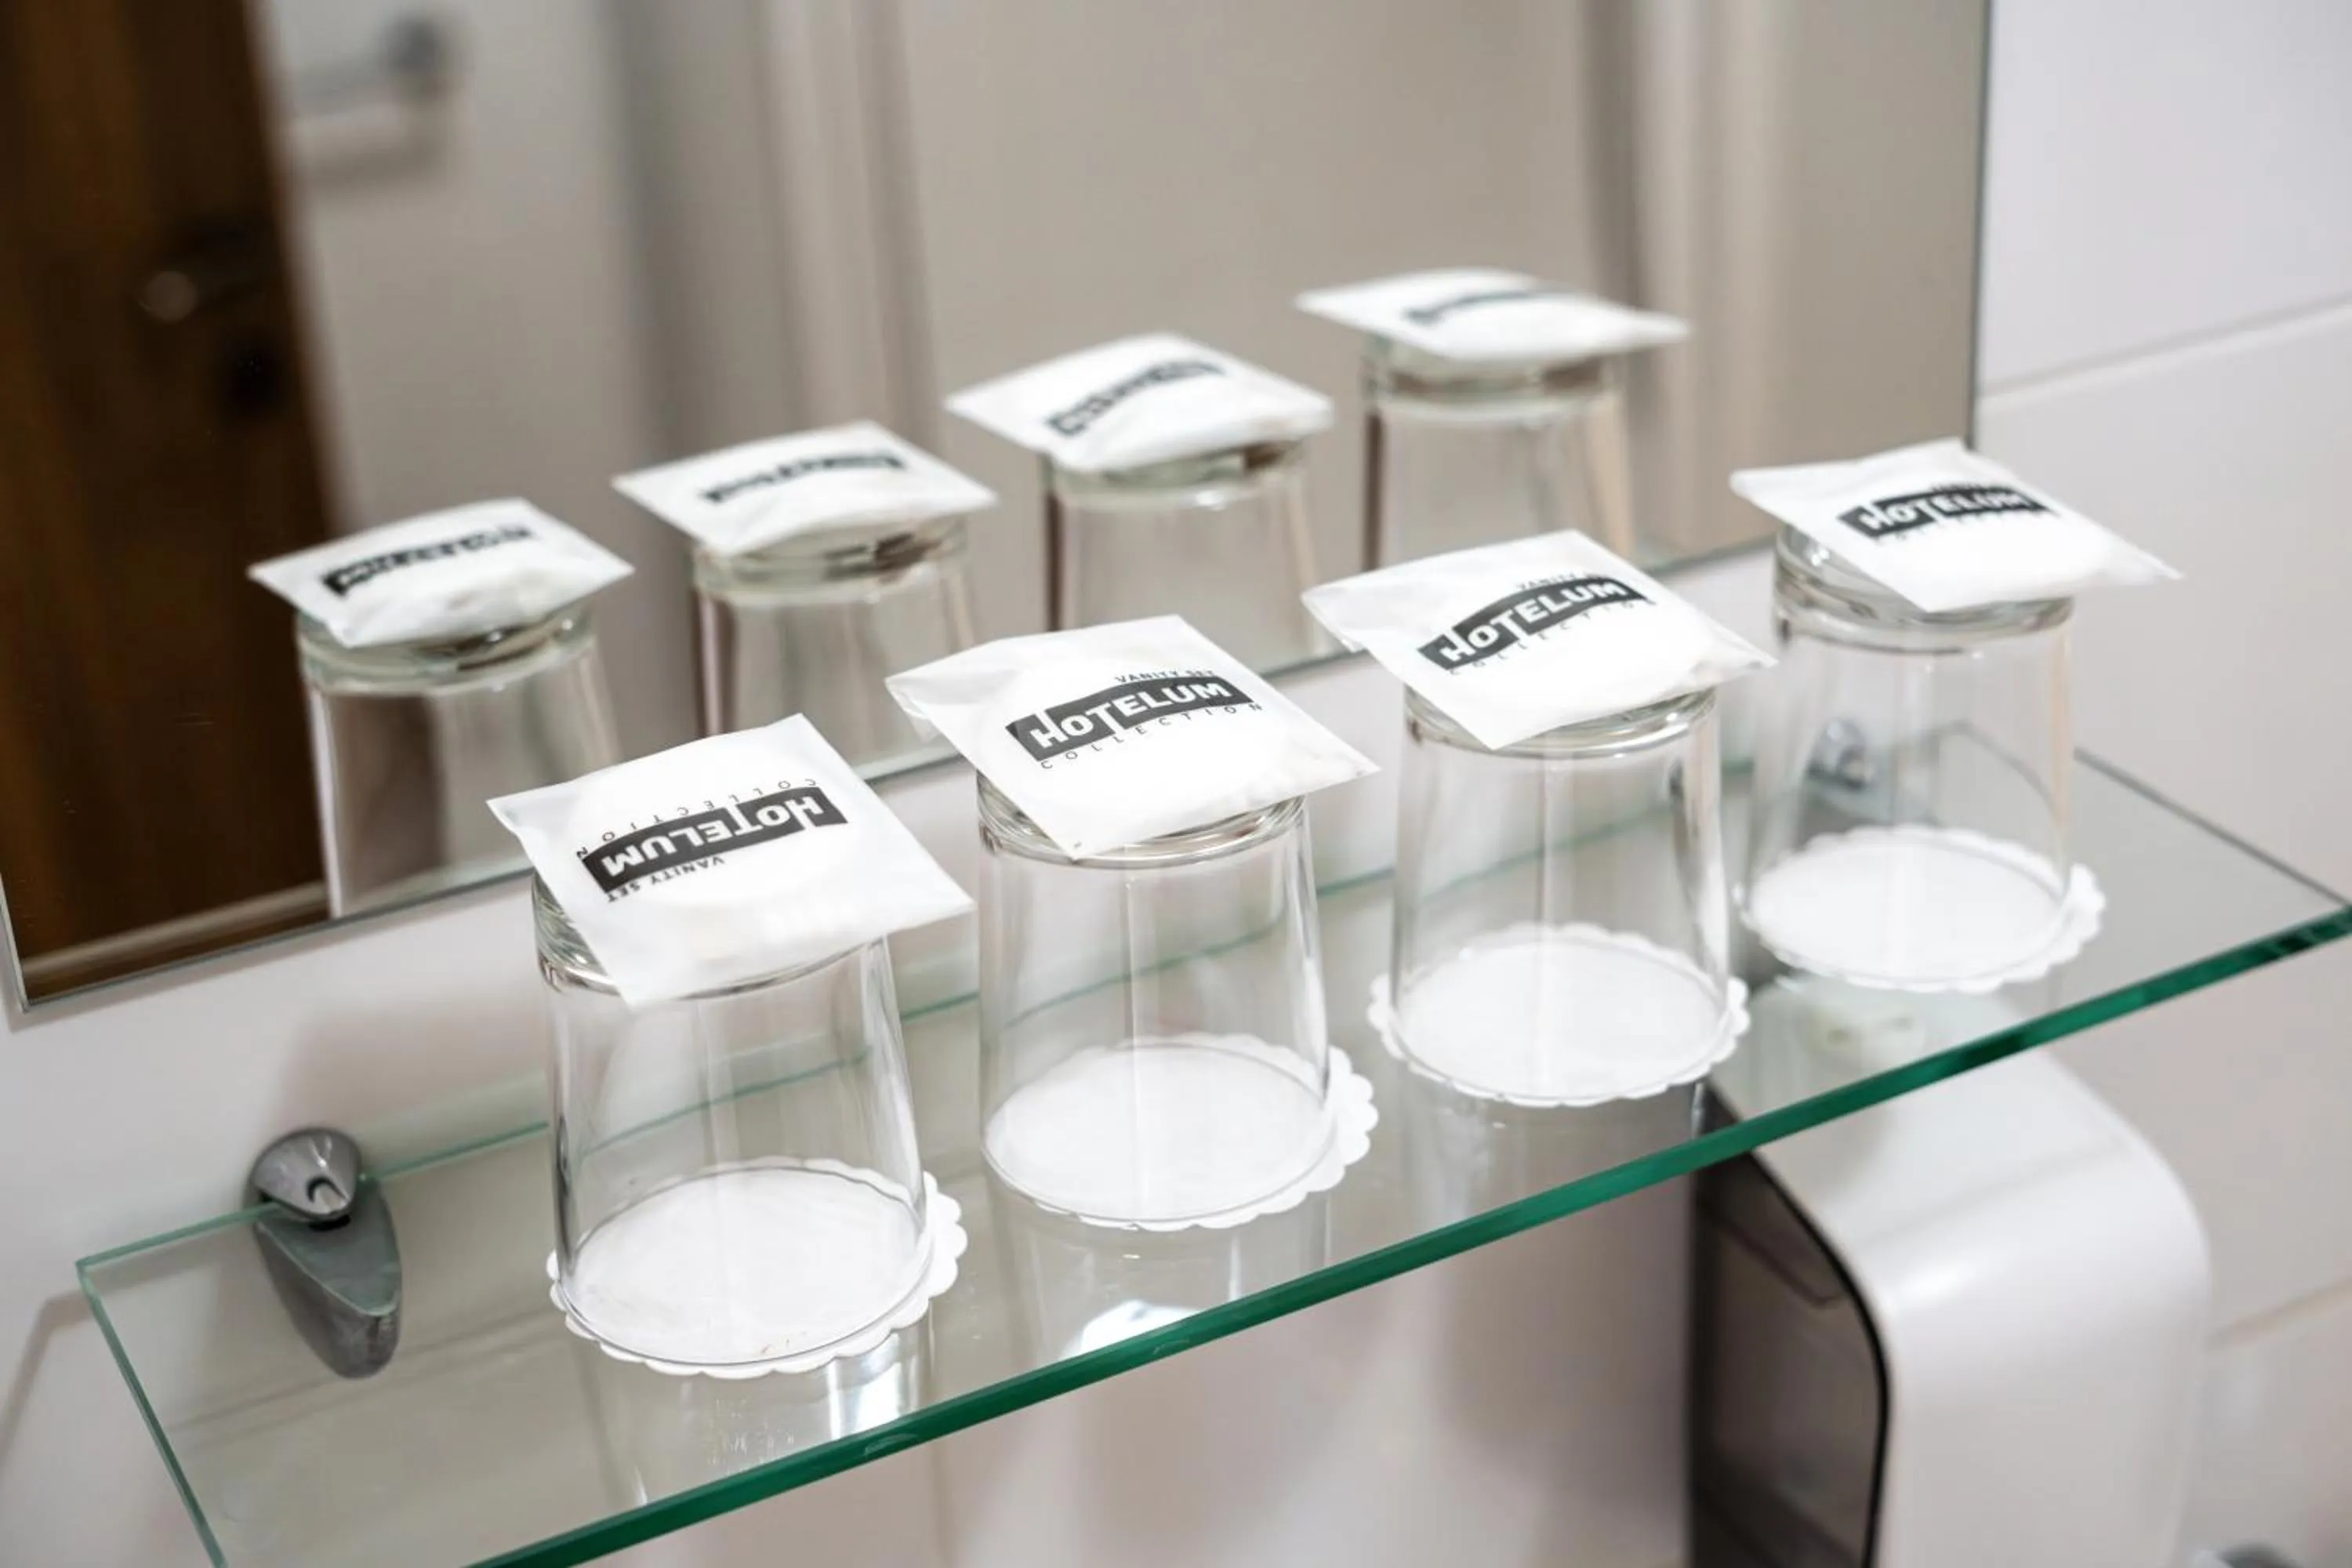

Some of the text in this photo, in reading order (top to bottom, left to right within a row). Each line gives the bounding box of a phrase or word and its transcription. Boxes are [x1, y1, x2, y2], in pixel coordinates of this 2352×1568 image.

[1439, 582, 1630, 662] HOTELUM
[1115, 670, 1181, 684] VANITY
[1029, 683, 1233, 749] HOTELUM
[1040, 703, 1264, 769] COLLECTION
[576, 779, 817, 858] COLLECTION
[601, 796, 824, 877] HOTELUM
[607, 856, 726, 902] VANITY SET
